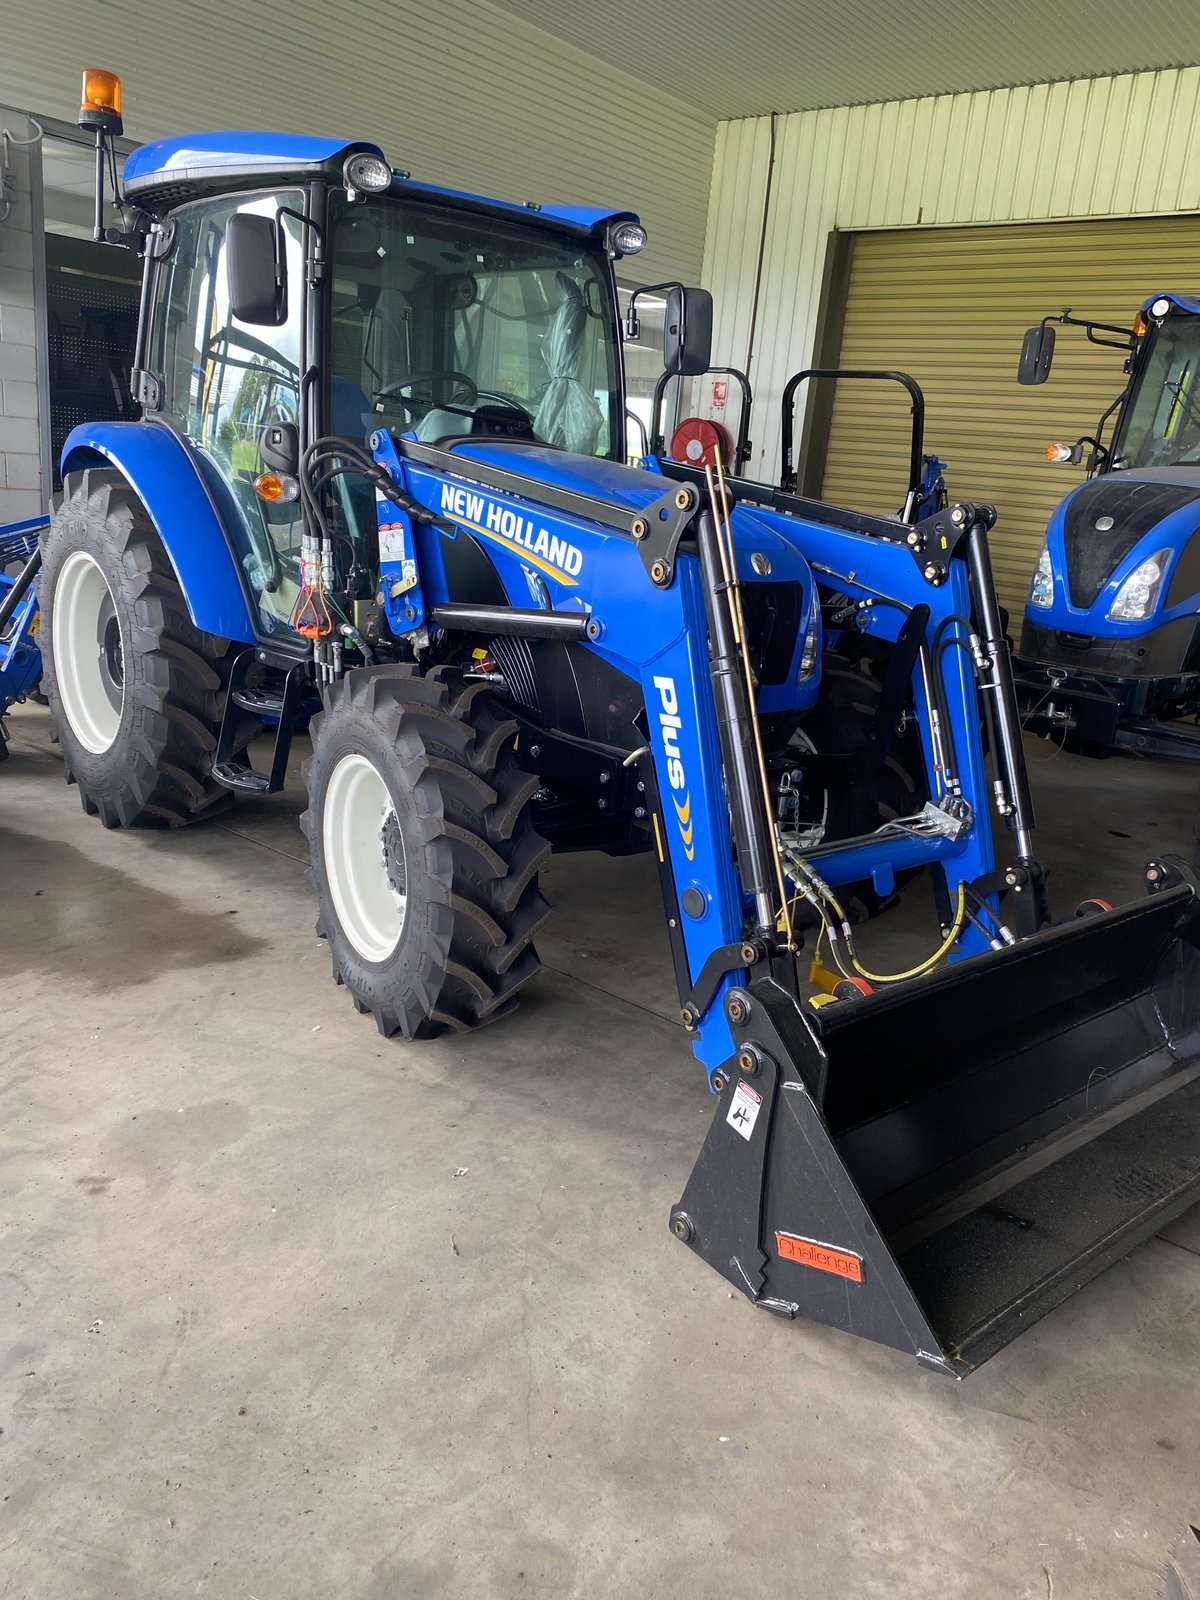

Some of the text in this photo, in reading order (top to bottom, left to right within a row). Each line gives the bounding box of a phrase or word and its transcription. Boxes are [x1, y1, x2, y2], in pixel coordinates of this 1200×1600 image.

[440, 483, 485, 523] NEW
[485, 502, 583, 576] HOLLAND
[653, 675, 686, 790] plus
[778, 1238, 859, 1274] Challenge
